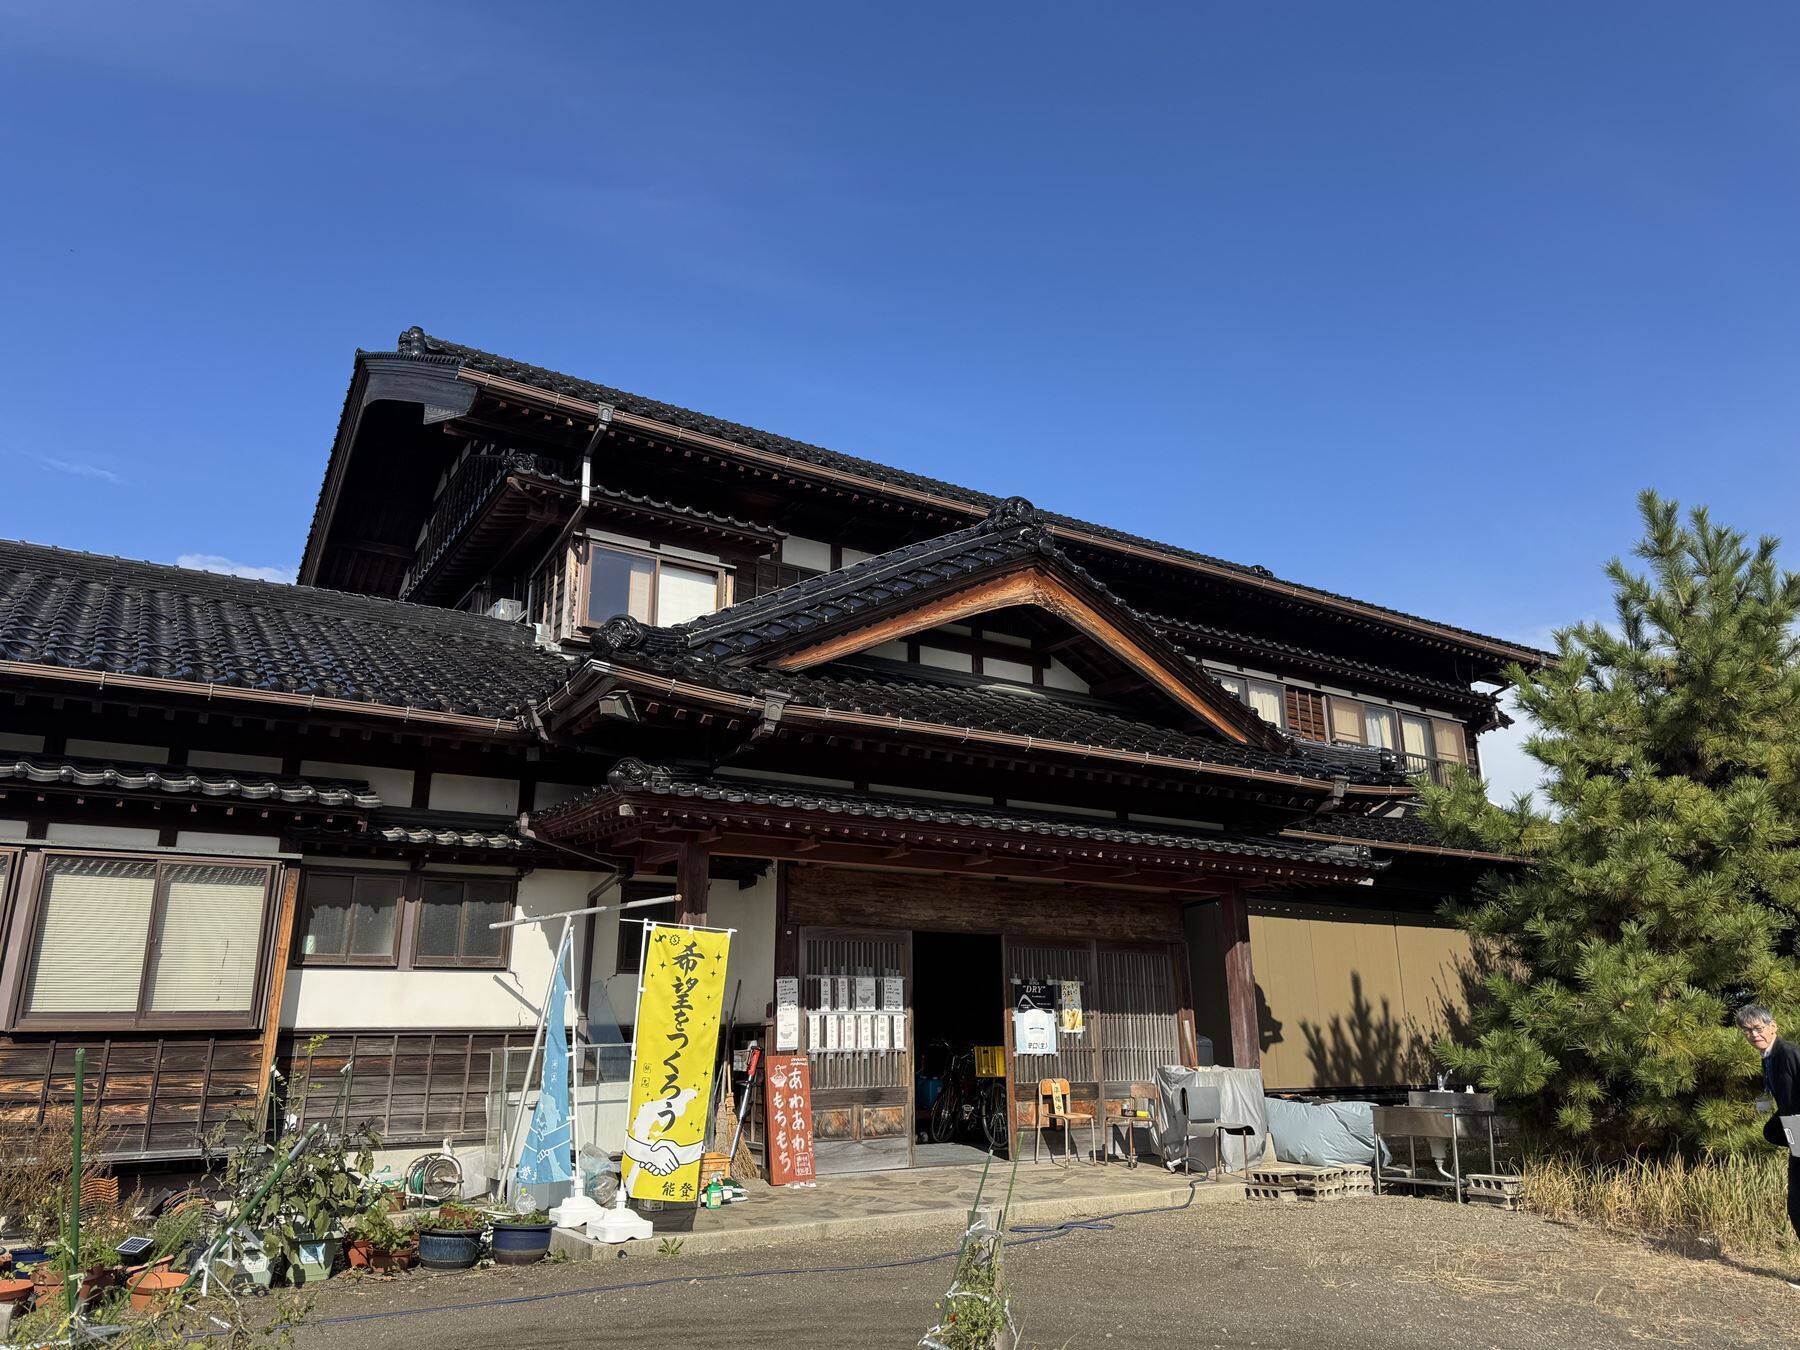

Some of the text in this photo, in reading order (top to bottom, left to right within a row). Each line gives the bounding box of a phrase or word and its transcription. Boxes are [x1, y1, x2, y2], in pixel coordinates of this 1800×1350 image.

[658, 940, 705, 1133] 希望をつくろう
[774, 1091, 791, 1174] もちもち
[789, 1068, 805, 1151] あわあわ
[662, 1181, 695, 1198] 能登
